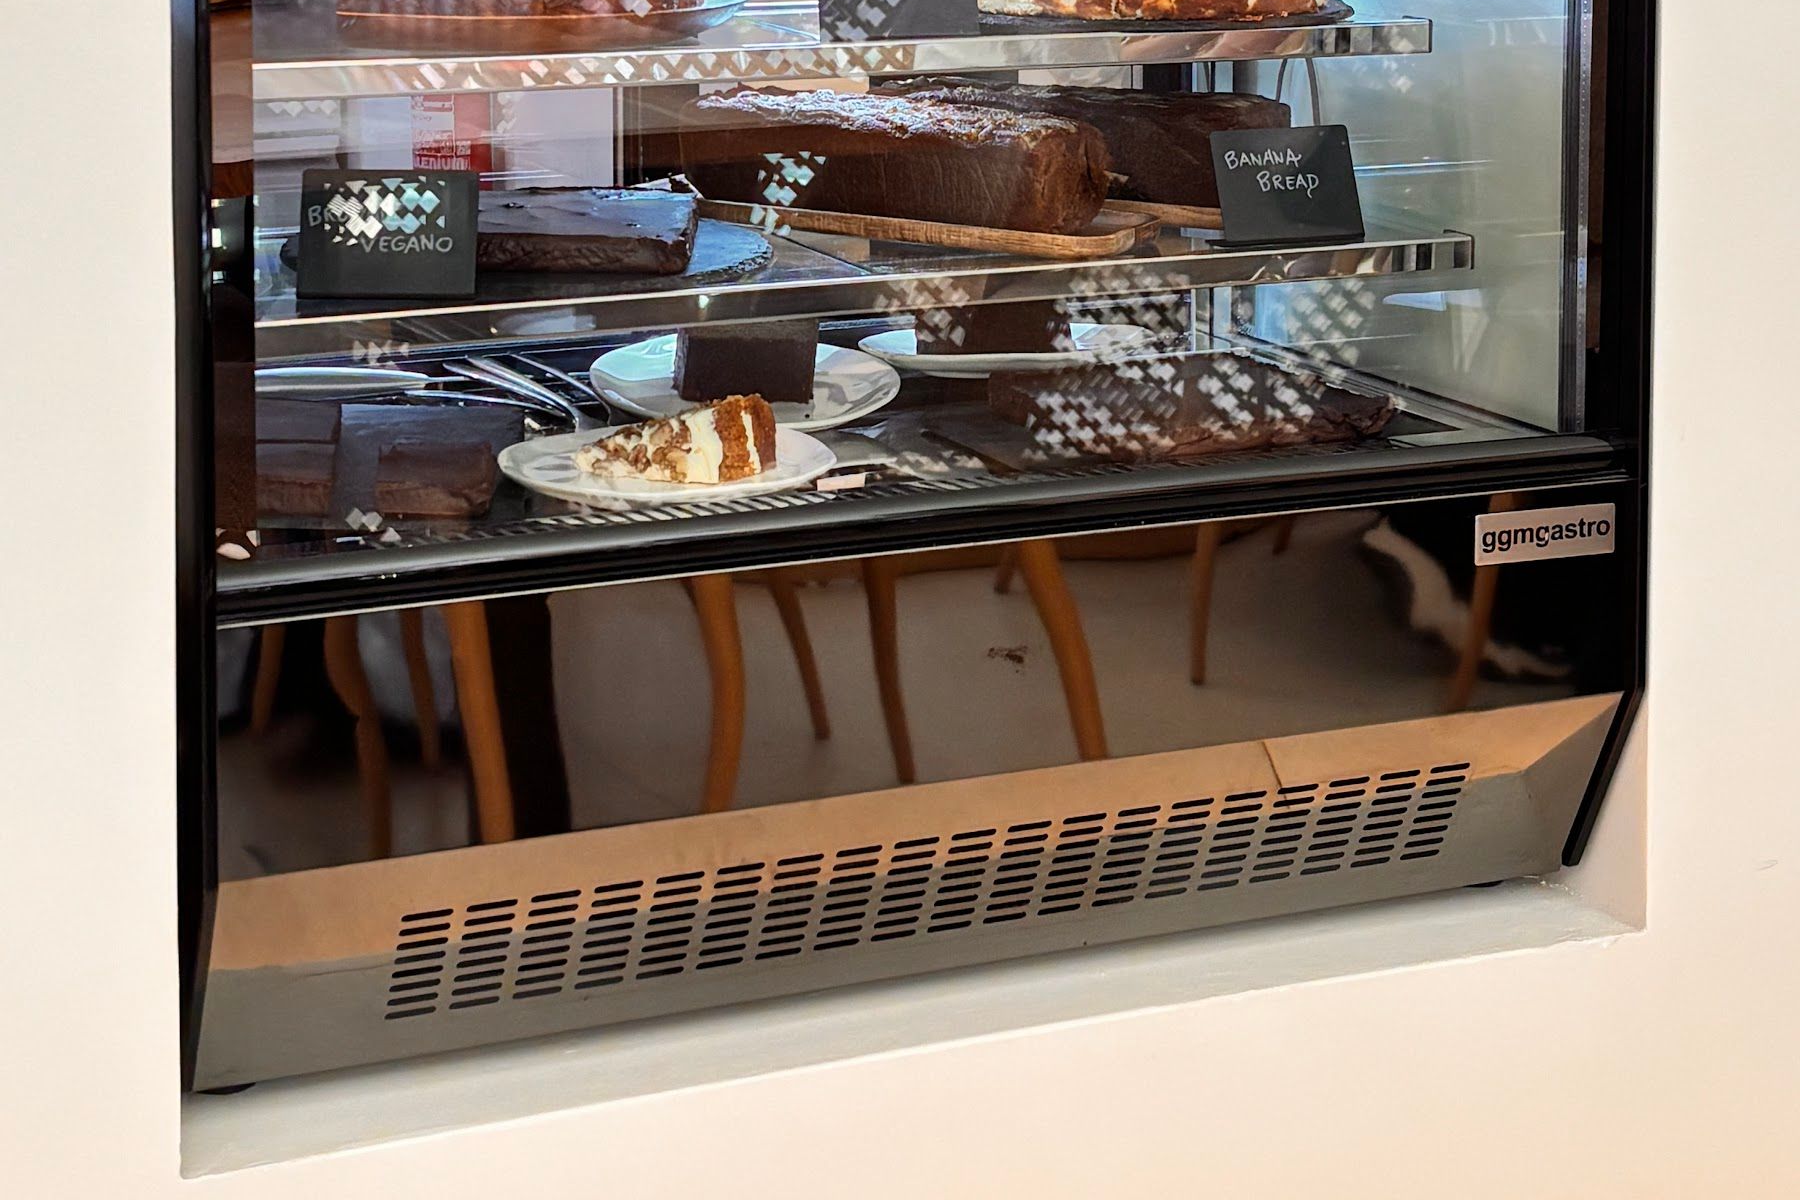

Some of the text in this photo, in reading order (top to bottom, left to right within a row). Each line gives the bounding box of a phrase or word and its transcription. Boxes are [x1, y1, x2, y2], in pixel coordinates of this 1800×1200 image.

[1224, 148, 1302, 170] BANANA
[1256, 170, 1319, 198] BREAD
[361, 234, 453, 254] VEGANO
[1482, 518, 1611, 553] ggmgastro
